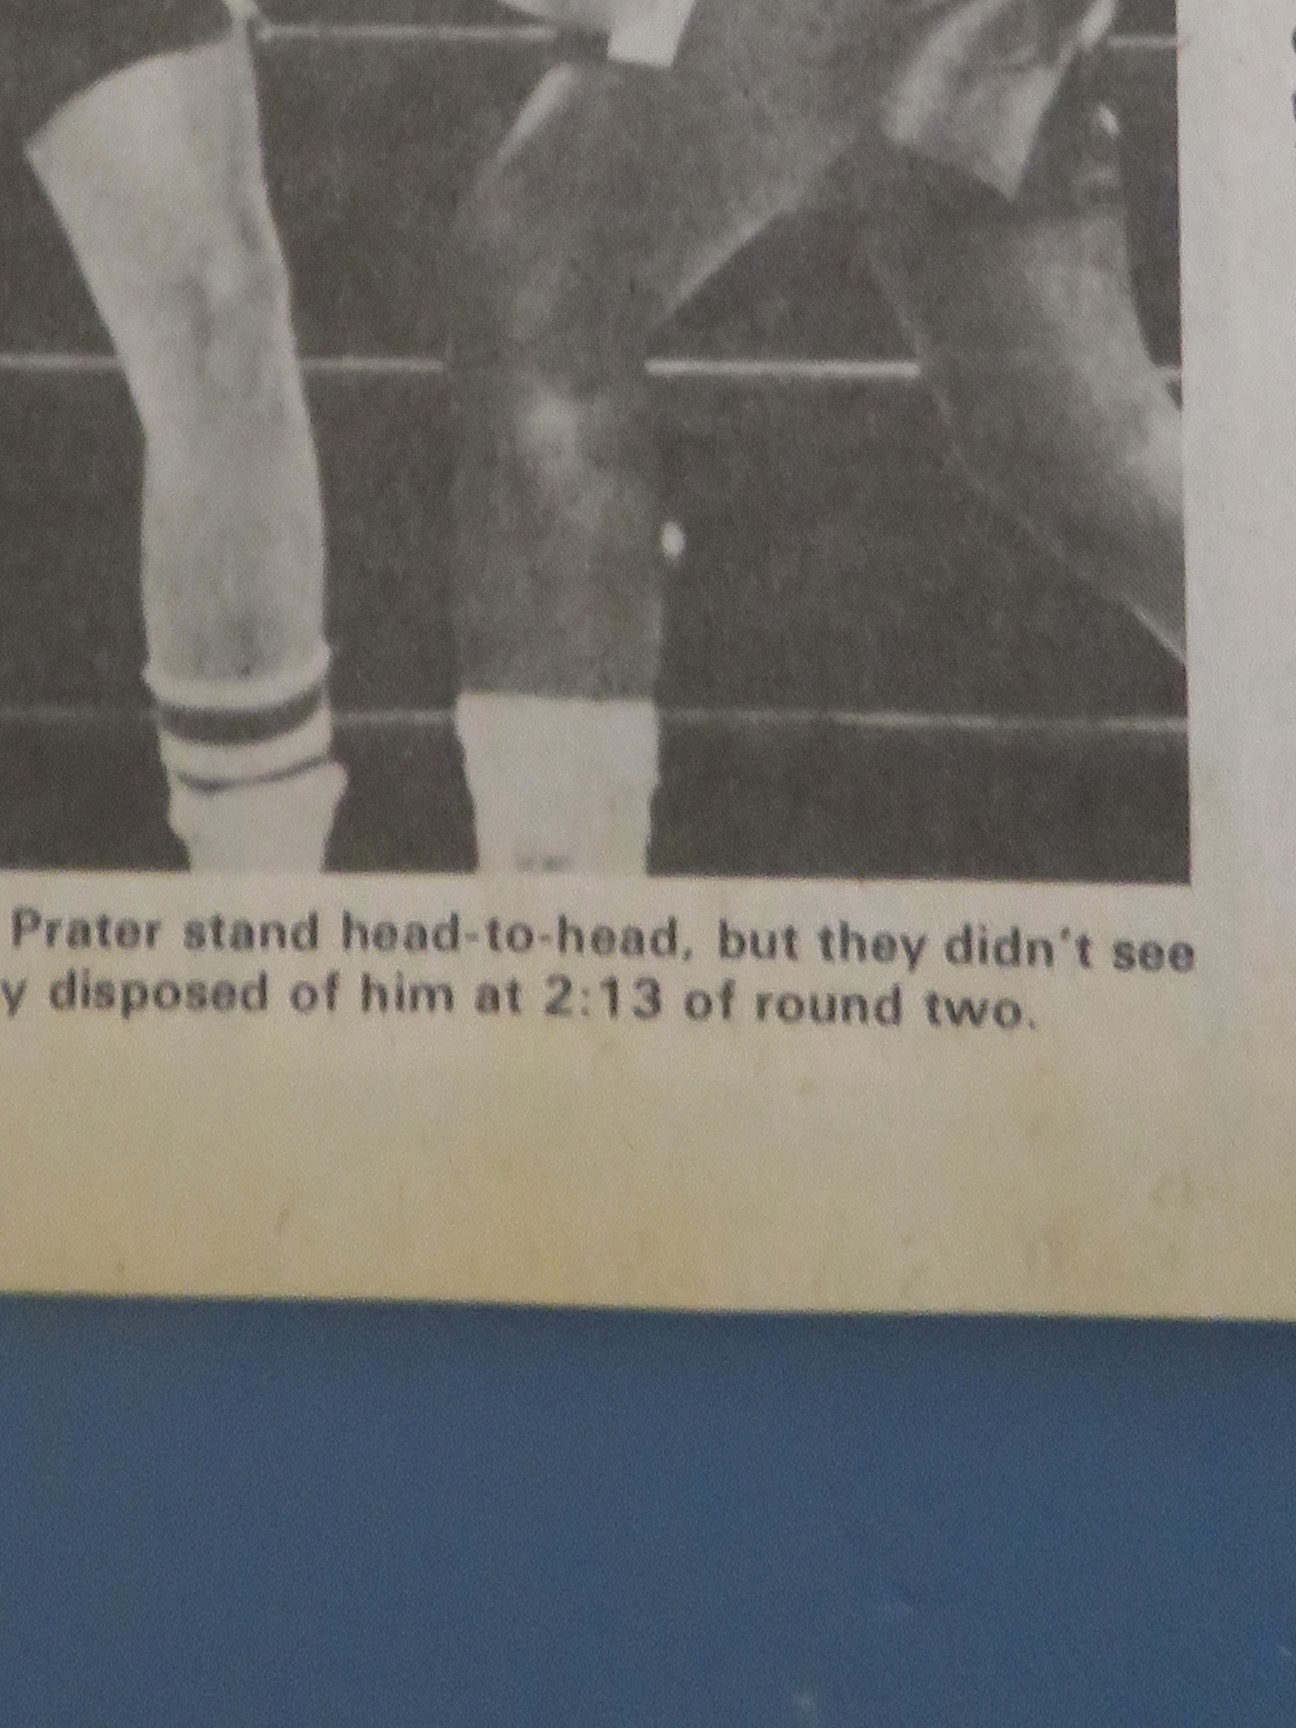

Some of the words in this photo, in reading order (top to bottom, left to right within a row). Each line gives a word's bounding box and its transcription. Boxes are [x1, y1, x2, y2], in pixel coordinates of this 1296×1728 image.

[9, 904, 164, 952] Prater
[181, 908, 322, 955] stand
[339, 907, 695, 964] head-to-head,
[716, 915, 801, 964] but
[815, 918, 930, 976] they
[942, 920, 1095, 972] didn't
[1110, 937, 1198, 976] see
[46, 965, 271, 1023] disposed
[287, 967, 343, 1016] of
[358, 968, 457, 1016] him
[472, 975, 524, 1018] at
[542, 971, 665, 1023] 2:13
[681, 976, 738, 1024] of
[753, 980, 905, 1029] round
[922, 988, 1038, 1032] two.
